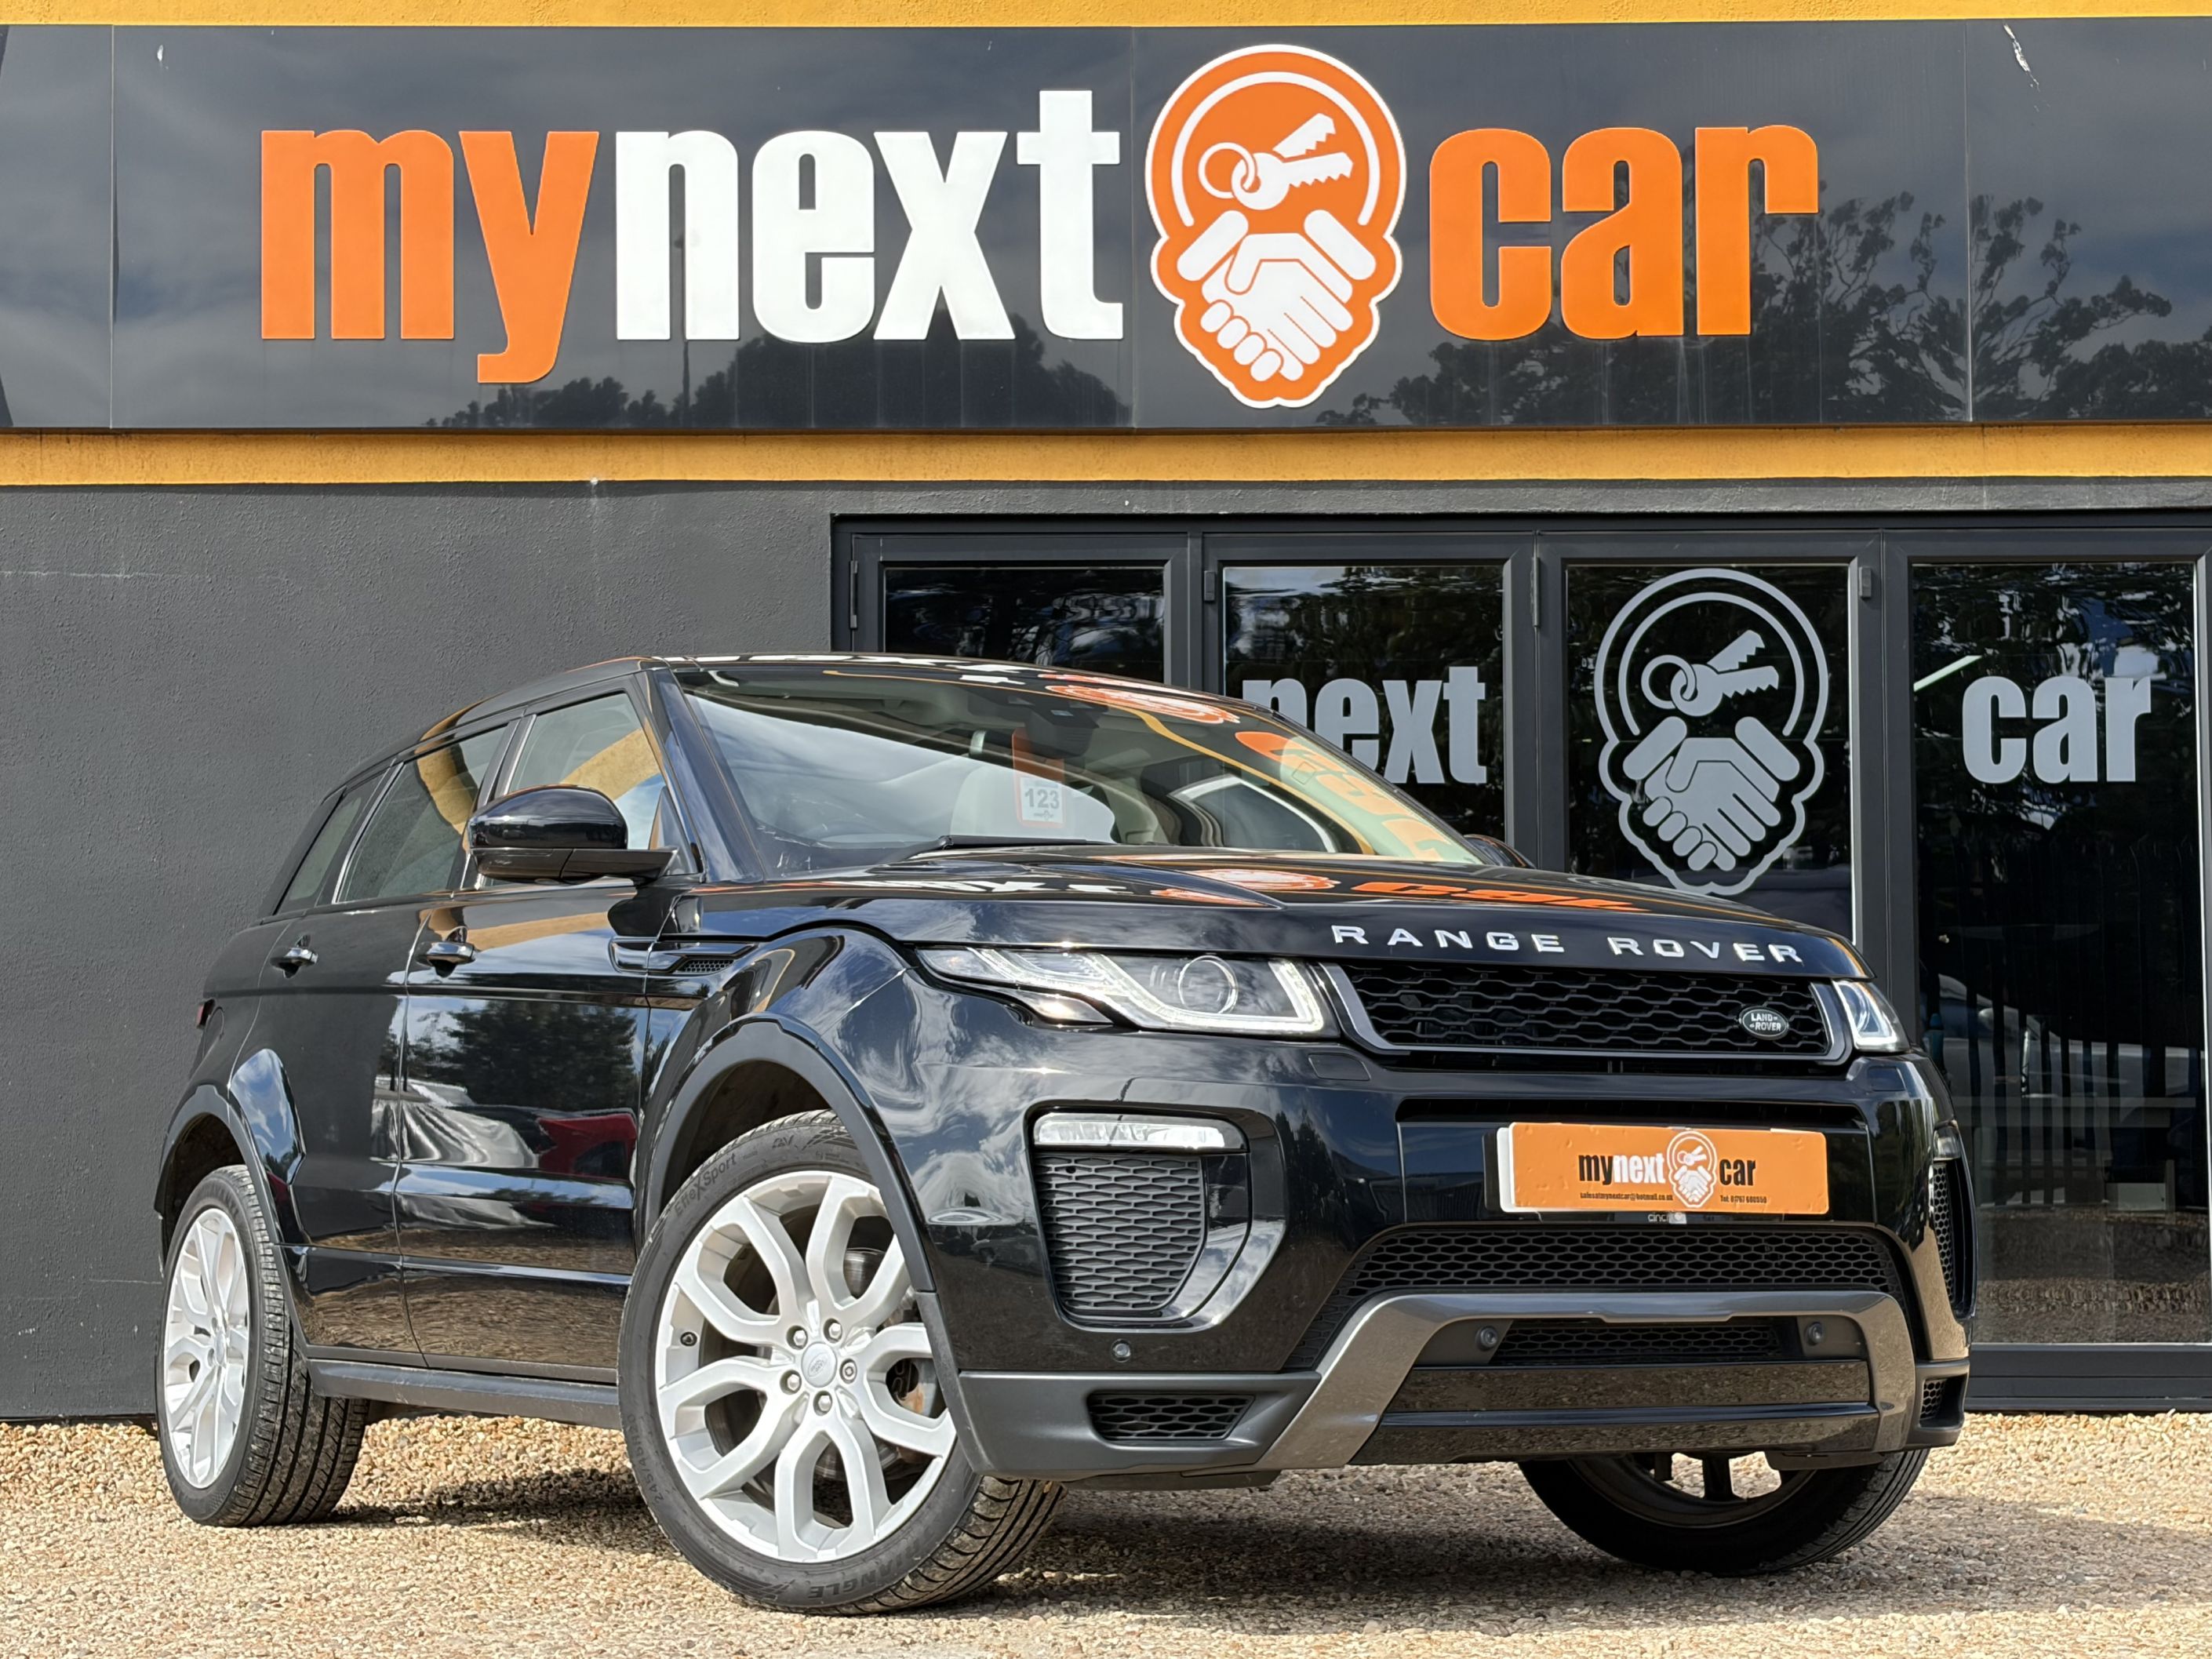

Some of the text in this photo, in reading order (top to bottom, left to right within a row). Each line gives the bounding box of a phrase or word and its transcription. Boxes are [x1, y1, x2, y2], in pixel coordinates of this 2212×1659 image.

[1429, 124, 1819, 341] car
[1963, 675, 2152, 784] car
[1024, 788, 1060, 809] 123
[1331, 925, 1803, 963] RANGE ROVER
[1719, 1159, 1756, 1186] car
[1647, 1212, 1669, 1223] cinc
